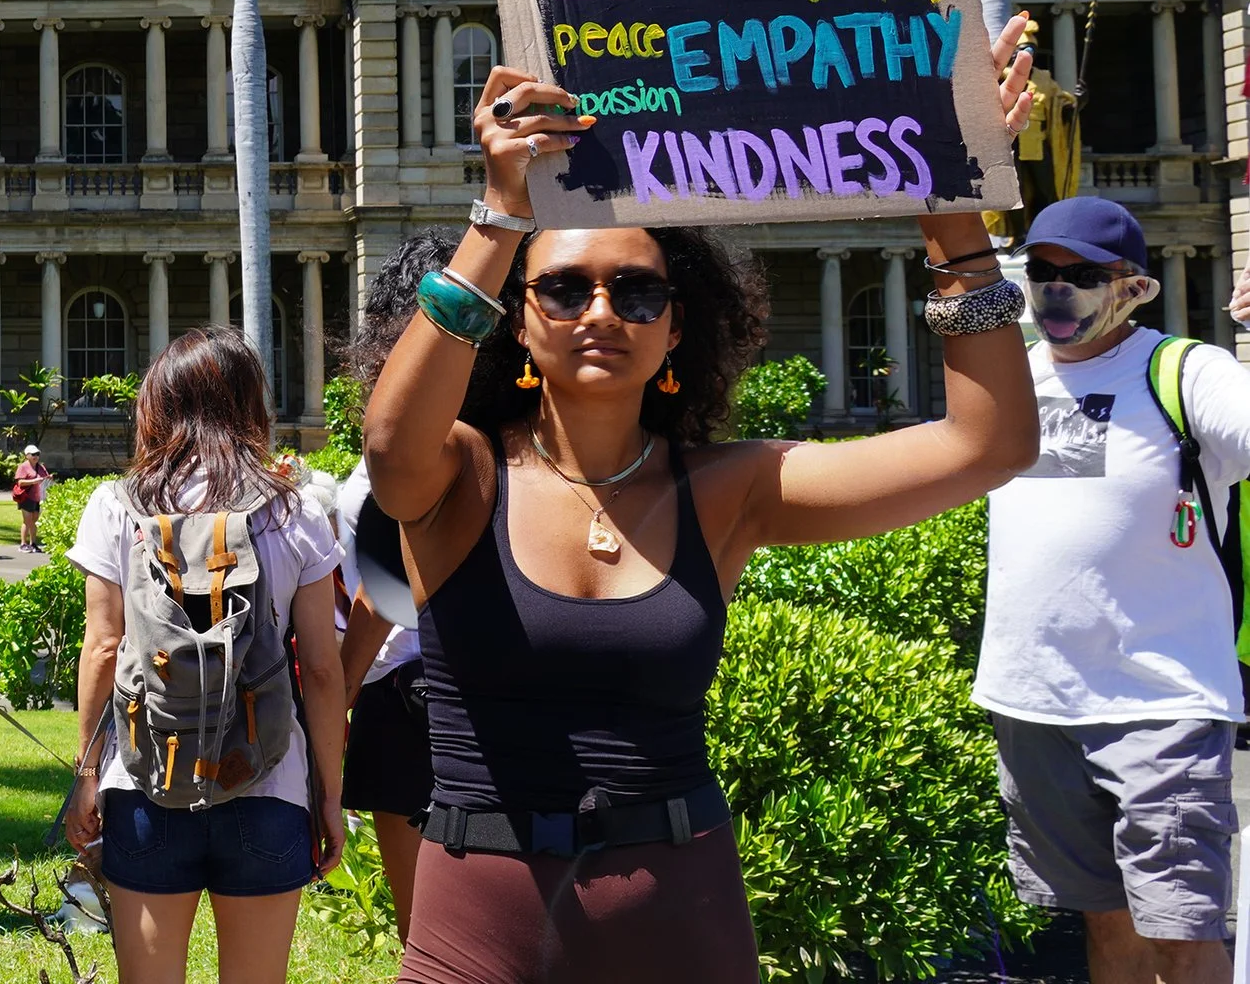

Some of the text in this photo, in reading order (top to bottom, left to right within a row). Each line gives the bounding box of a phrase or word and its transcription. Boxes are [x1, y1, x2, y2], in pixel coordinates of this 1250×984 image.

[552, 21, 666, 67] peace
[666, 7, 962, 93] EMPATHY
[528, 78, 682, 116] passion
[621, 116, 933, 204] KINDNESS
